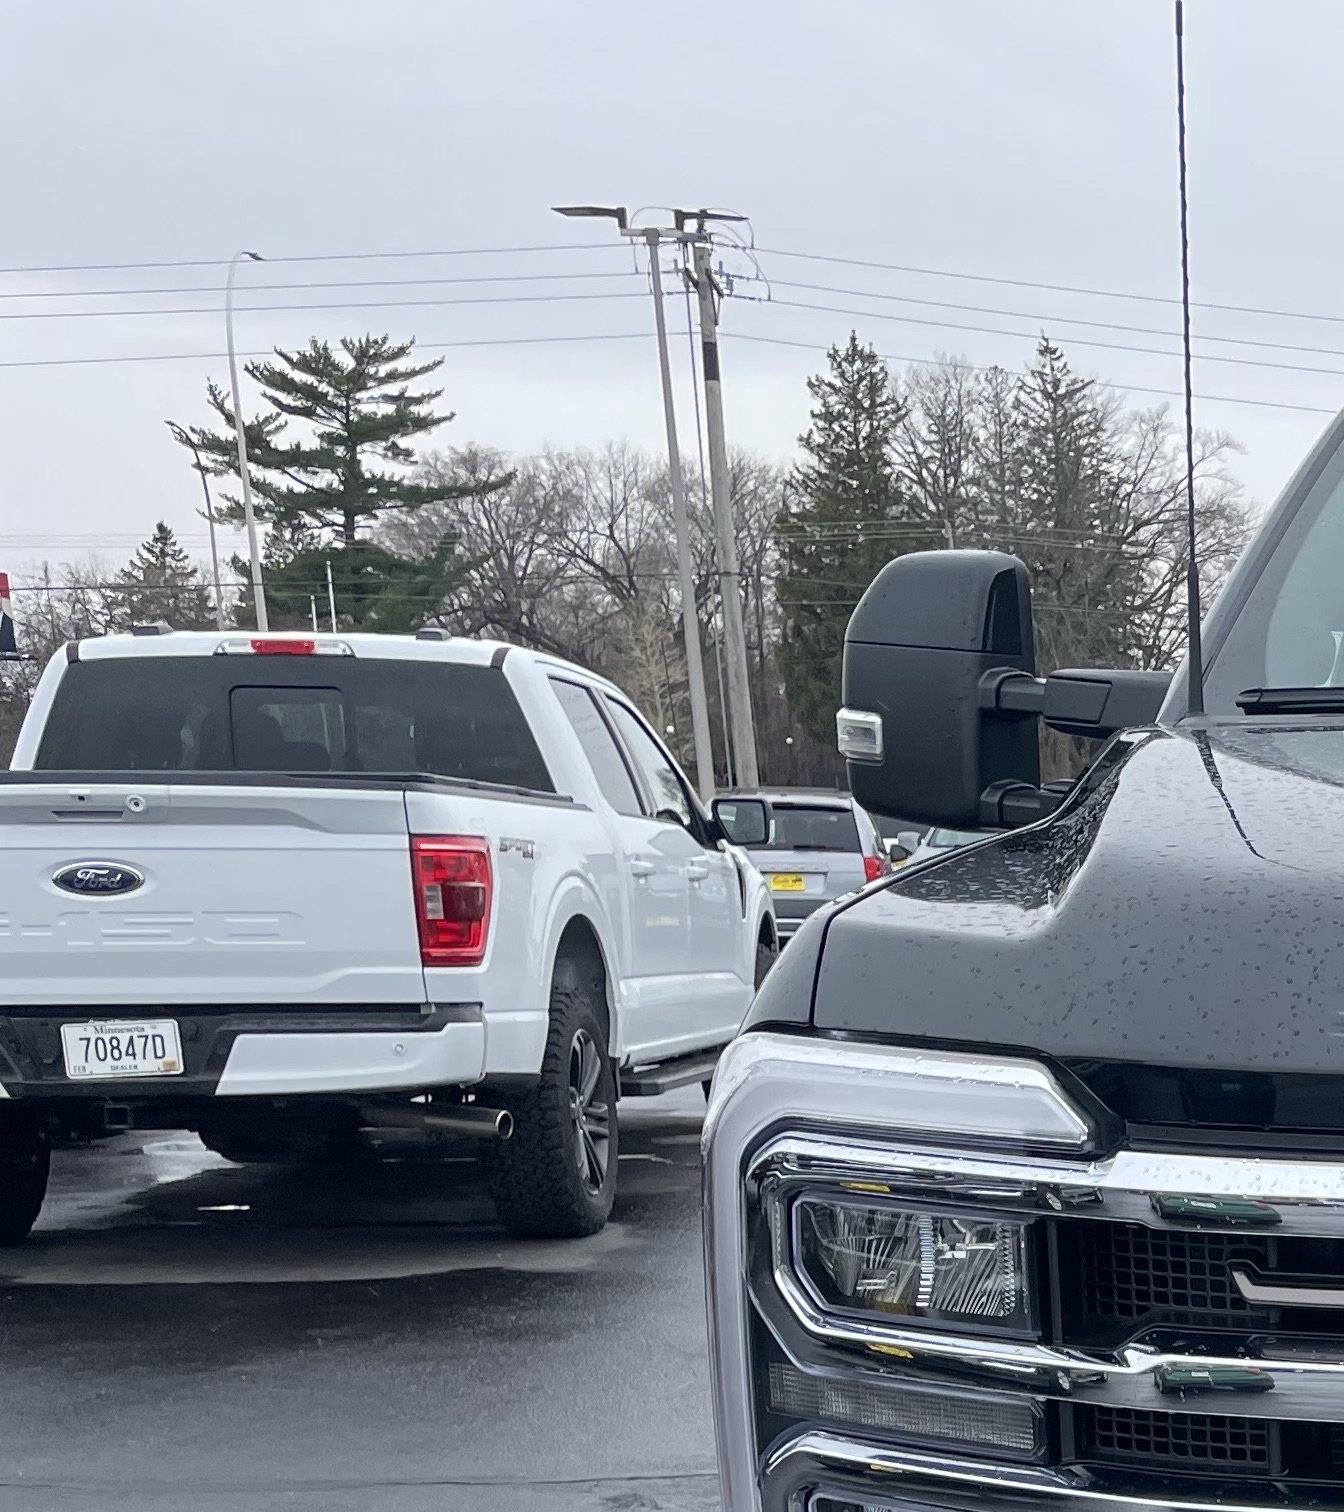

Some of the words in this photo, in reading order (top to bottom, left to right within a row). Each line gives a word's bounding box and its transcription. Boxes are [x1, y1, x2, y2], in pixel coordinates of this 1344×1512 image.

[74, 868, 122, 889] Ford
[93, 1025, 145, 1035] Minnesota
[79, 1034, 166, 1063] 70847D
